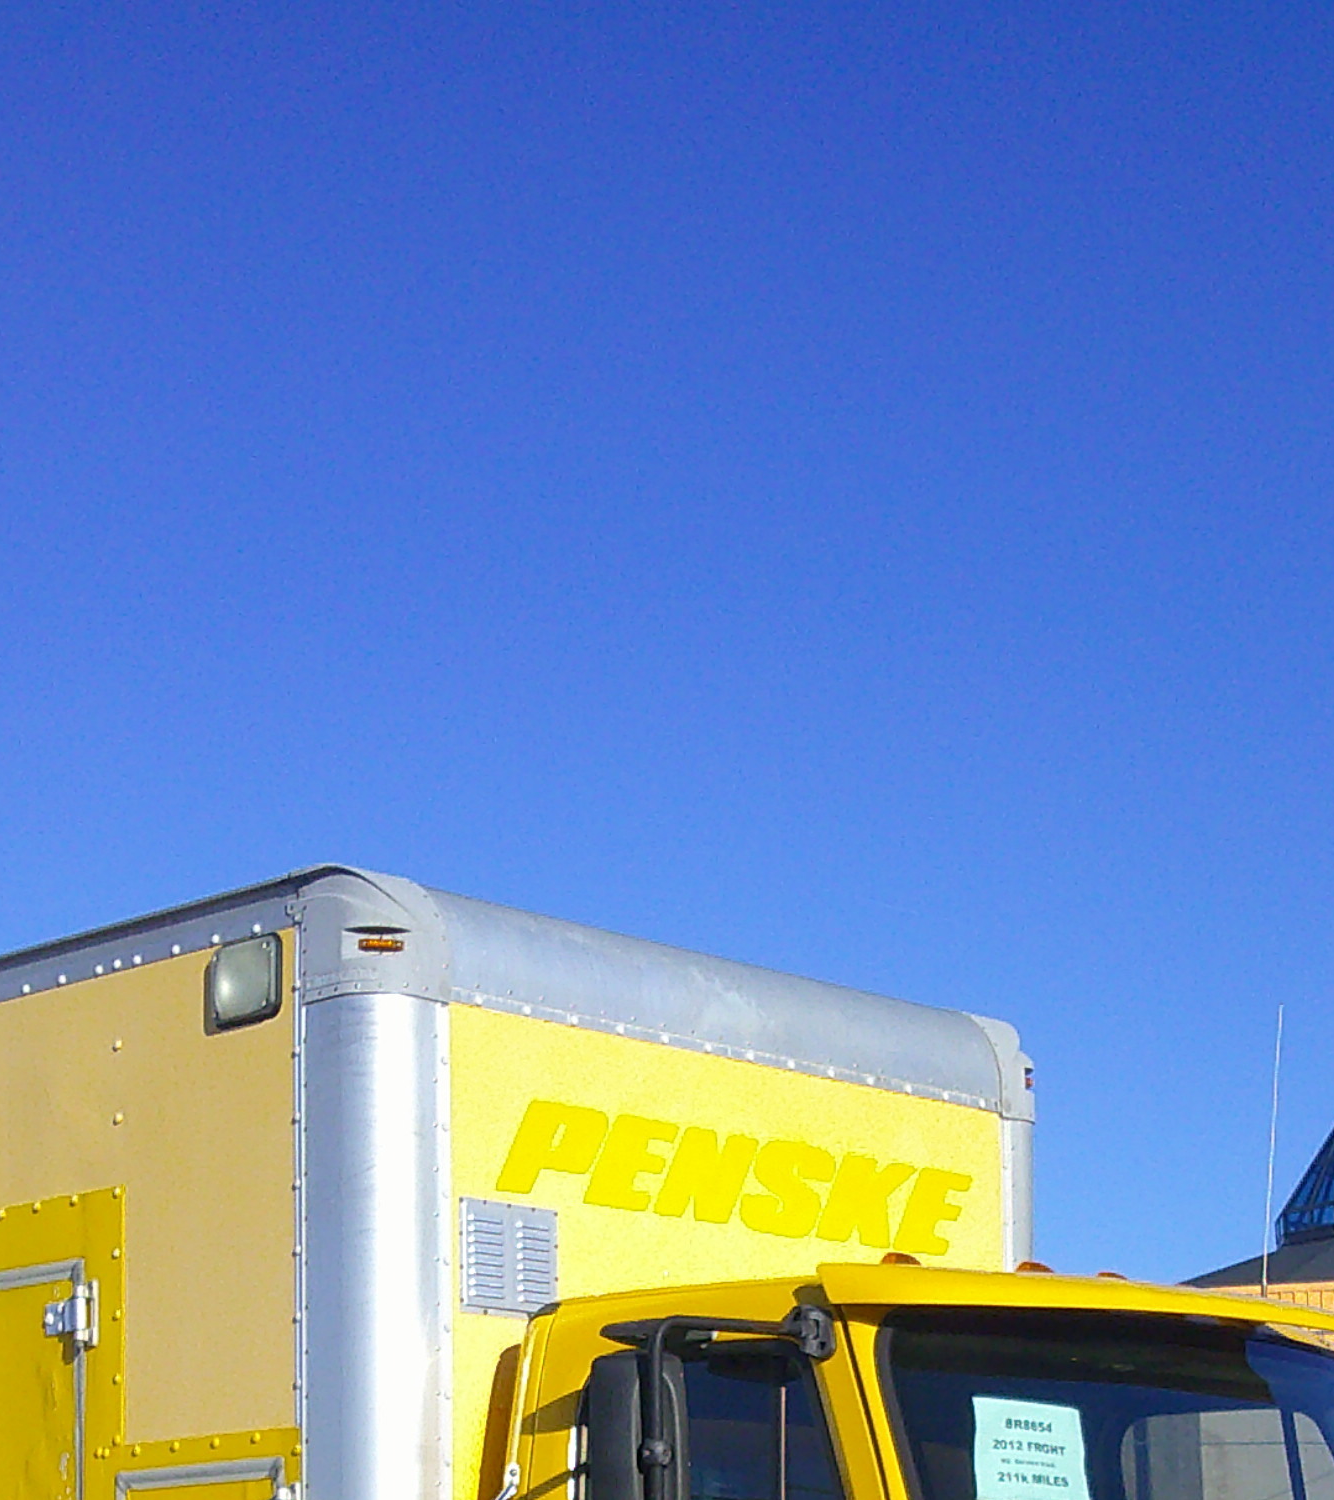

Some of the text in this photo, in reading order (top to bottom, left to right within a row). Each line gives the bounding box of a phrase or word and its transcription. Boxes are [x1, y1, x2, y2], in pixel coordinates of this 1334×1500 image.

[496, 1099, 973, 1256] PENSKE
[993, 1439, 1065, 1455] 2012 FRGHT
[1032, 1474, 1069, 1487] MILES
